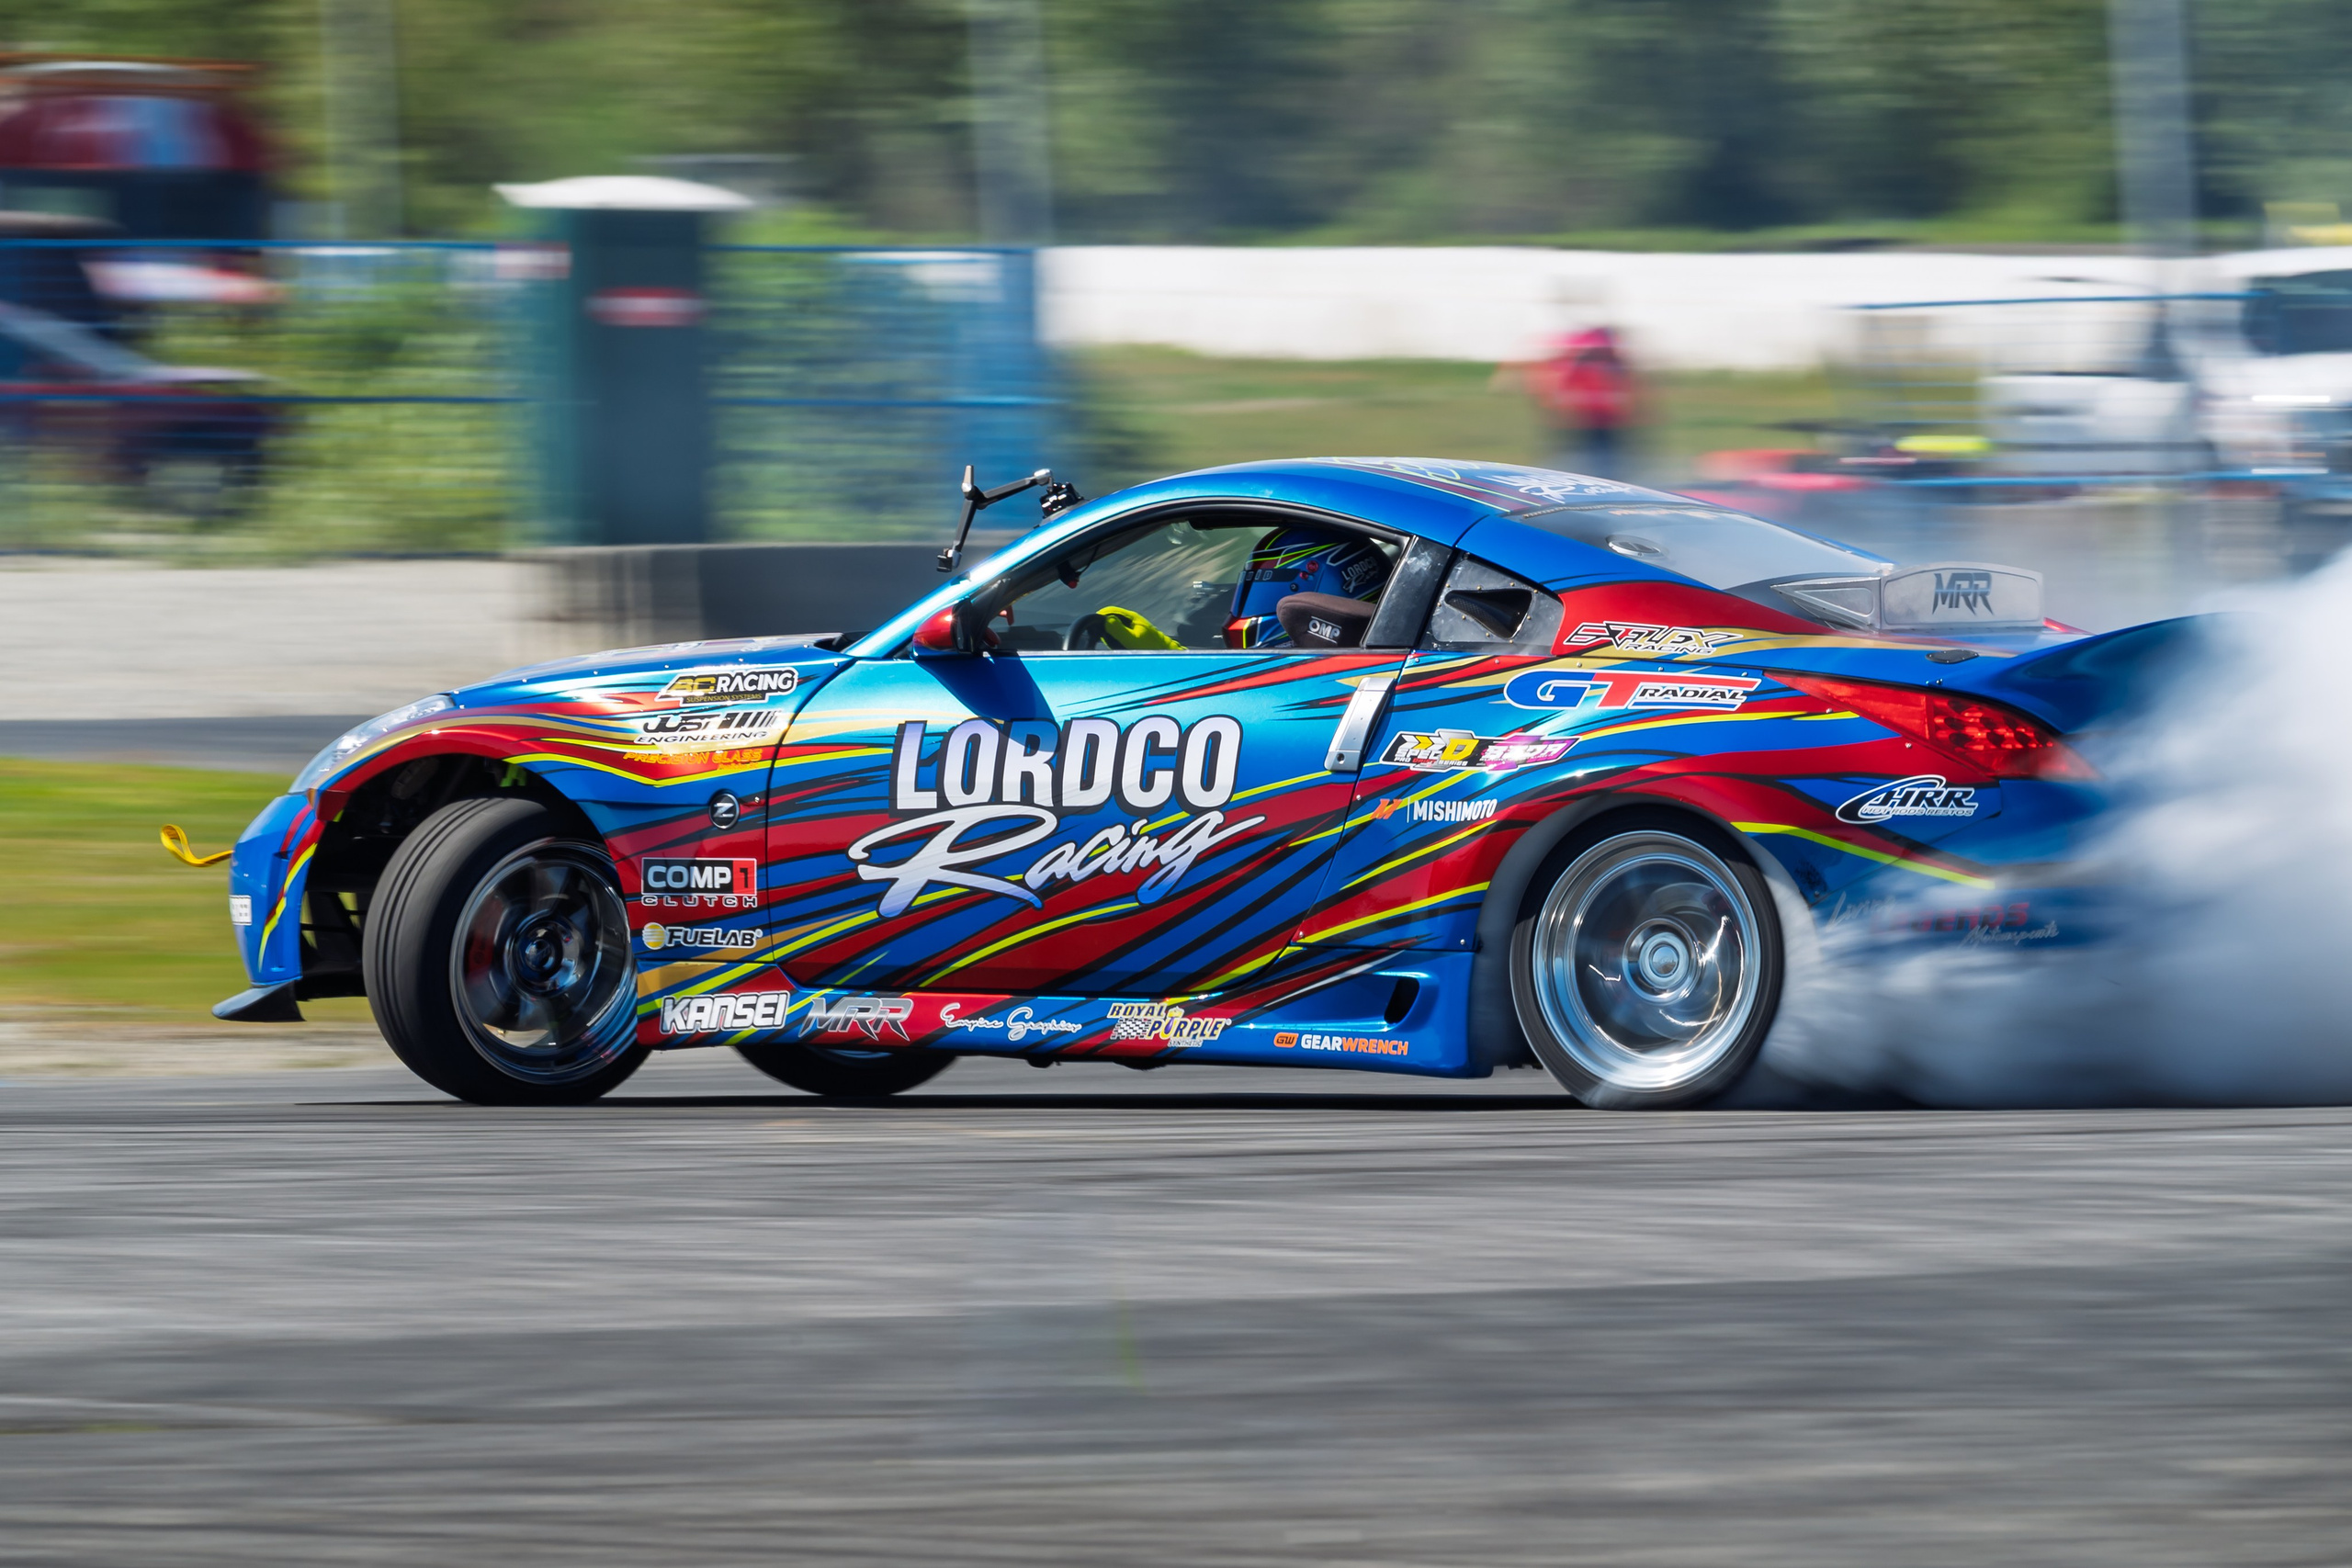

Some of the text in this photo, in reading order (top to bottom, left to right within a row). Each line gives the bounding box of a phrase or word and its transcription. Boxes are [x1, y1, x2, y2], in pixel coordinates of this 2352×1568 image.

[1932, 572, 1994, 615] MRR
[1308, 620, 1340, 639] OMP
[1624, 642, 1717, 655] RACING
[665, 671, 794, 694] BC RACING
[1503, 668, 1762, 711] GT RADIAL
[686, 693, 763, 704] SUSPENSION SYSTEMS
[636, 731, 768, 743] ENGINEERING
[623, 749, 763, 765] PRECISION GLASS
[892, 715, 1243, 814] LORDCO
[1395, 748, 1443, 760] SPEC
[1868, 787, 1978, 808] HRR
[1413, 799, 1498, 821] MISHIMOTO
[1891, 807, 1926, 816] RODS
[1926, 807, 1974, 816] RESTOS
[847, 804, 1266, 918] Racing
[647, 865, 749, 889] COMP 1
[641, 896, 758, 908] CLUTCH
[1871, 901, 2030, 935] EGENDS
[666, 926, 756, 948] FUELAB
[661, 991, 790, 1034] KANSEI
[798, 997, 913, 1042] MRR
[1107, 1002, 1168, 1019] ROYAL
[940, 1002, 1082, 1042] Empire Graphics
[1148, 1018, 1226, 1040] PURPLE
[1275, 1033, 1409, 1055] GW GEARWRENCH
